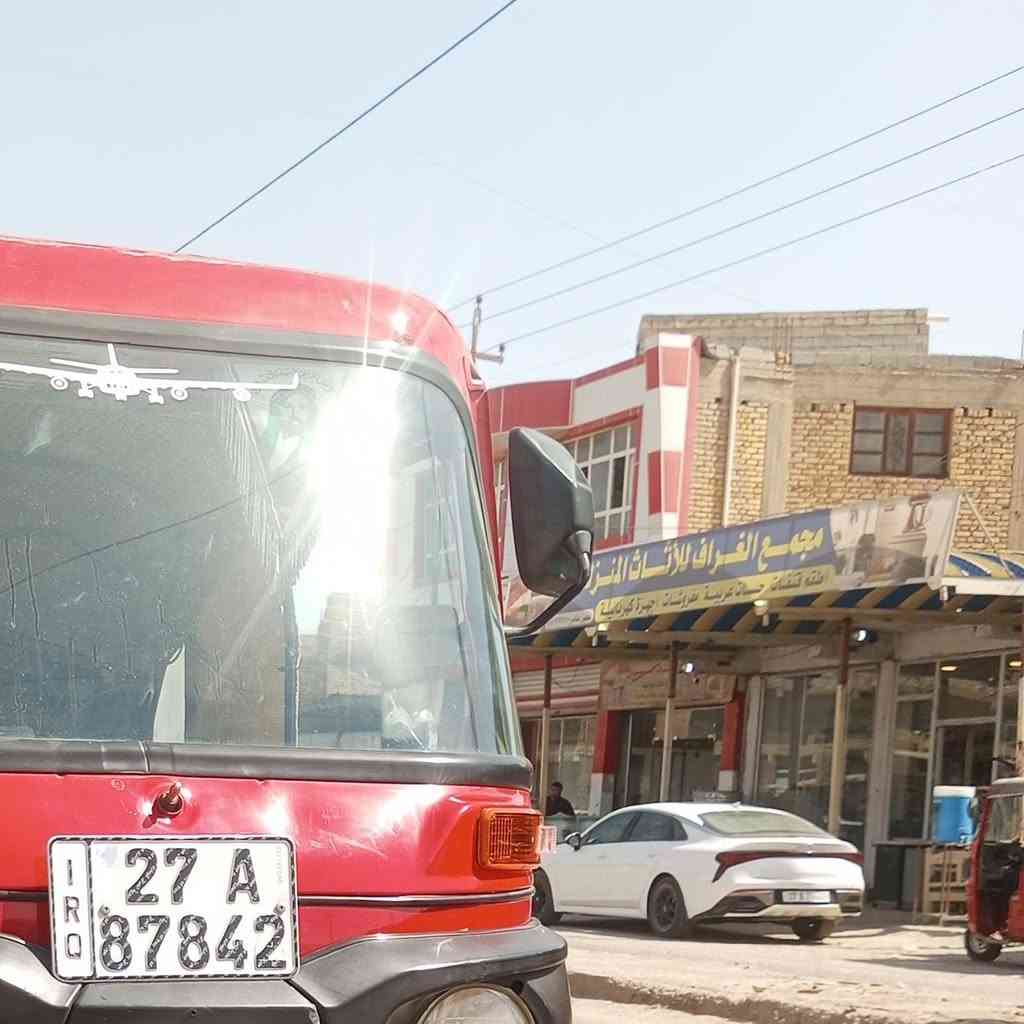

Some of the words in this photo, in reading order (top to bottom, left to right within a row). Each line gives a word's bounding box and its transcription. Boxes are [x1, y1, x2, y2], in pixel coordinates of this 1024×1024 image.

[757, 527, 824, 572] مجمع
[124, 847, 198, 905] 27
[225, 847, 262, 905] A
[99, 913, 288, 972] 87842
